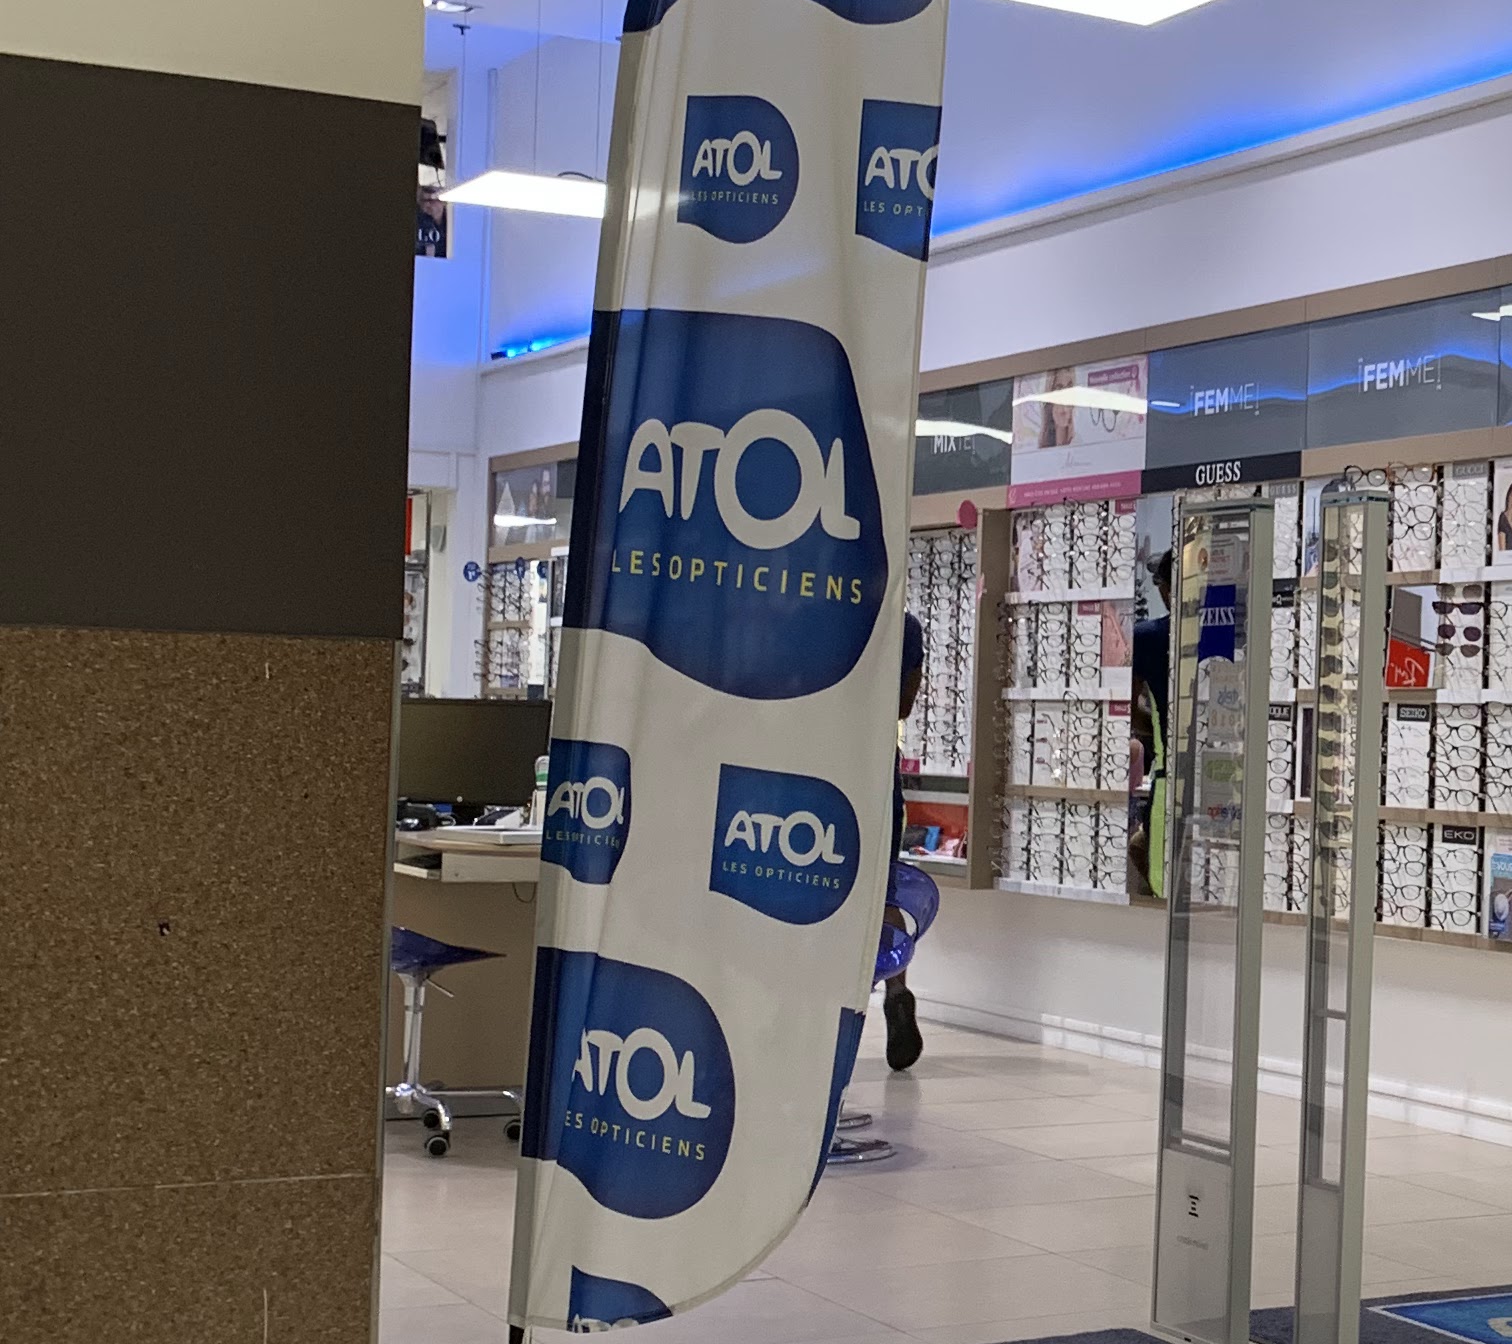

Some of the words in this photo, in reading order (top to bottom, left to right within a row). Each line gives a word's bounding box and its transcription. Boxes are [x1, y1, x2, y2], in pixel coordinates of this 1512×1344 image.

[692, 130, 782, 186] ATOL
[710, 191, 779, 205] OPTICIENS
[864, 201, 885, 213] LES
[619, 408, 861, 549] ATOL
[1196, 461, 1241, 485] GUESS
[1199, 605, 1236, 627] ZEISS
[725, 810, 845, 866] ATOL
[1443, 829, 1475, 841] EKO
[723, 861, 746, 874] LES
[755, 866, 840, 890] OPTICIENS
[565, 1111, 583, 1130] ES
[591, 1117, 705, 1161] OPTICIENS
